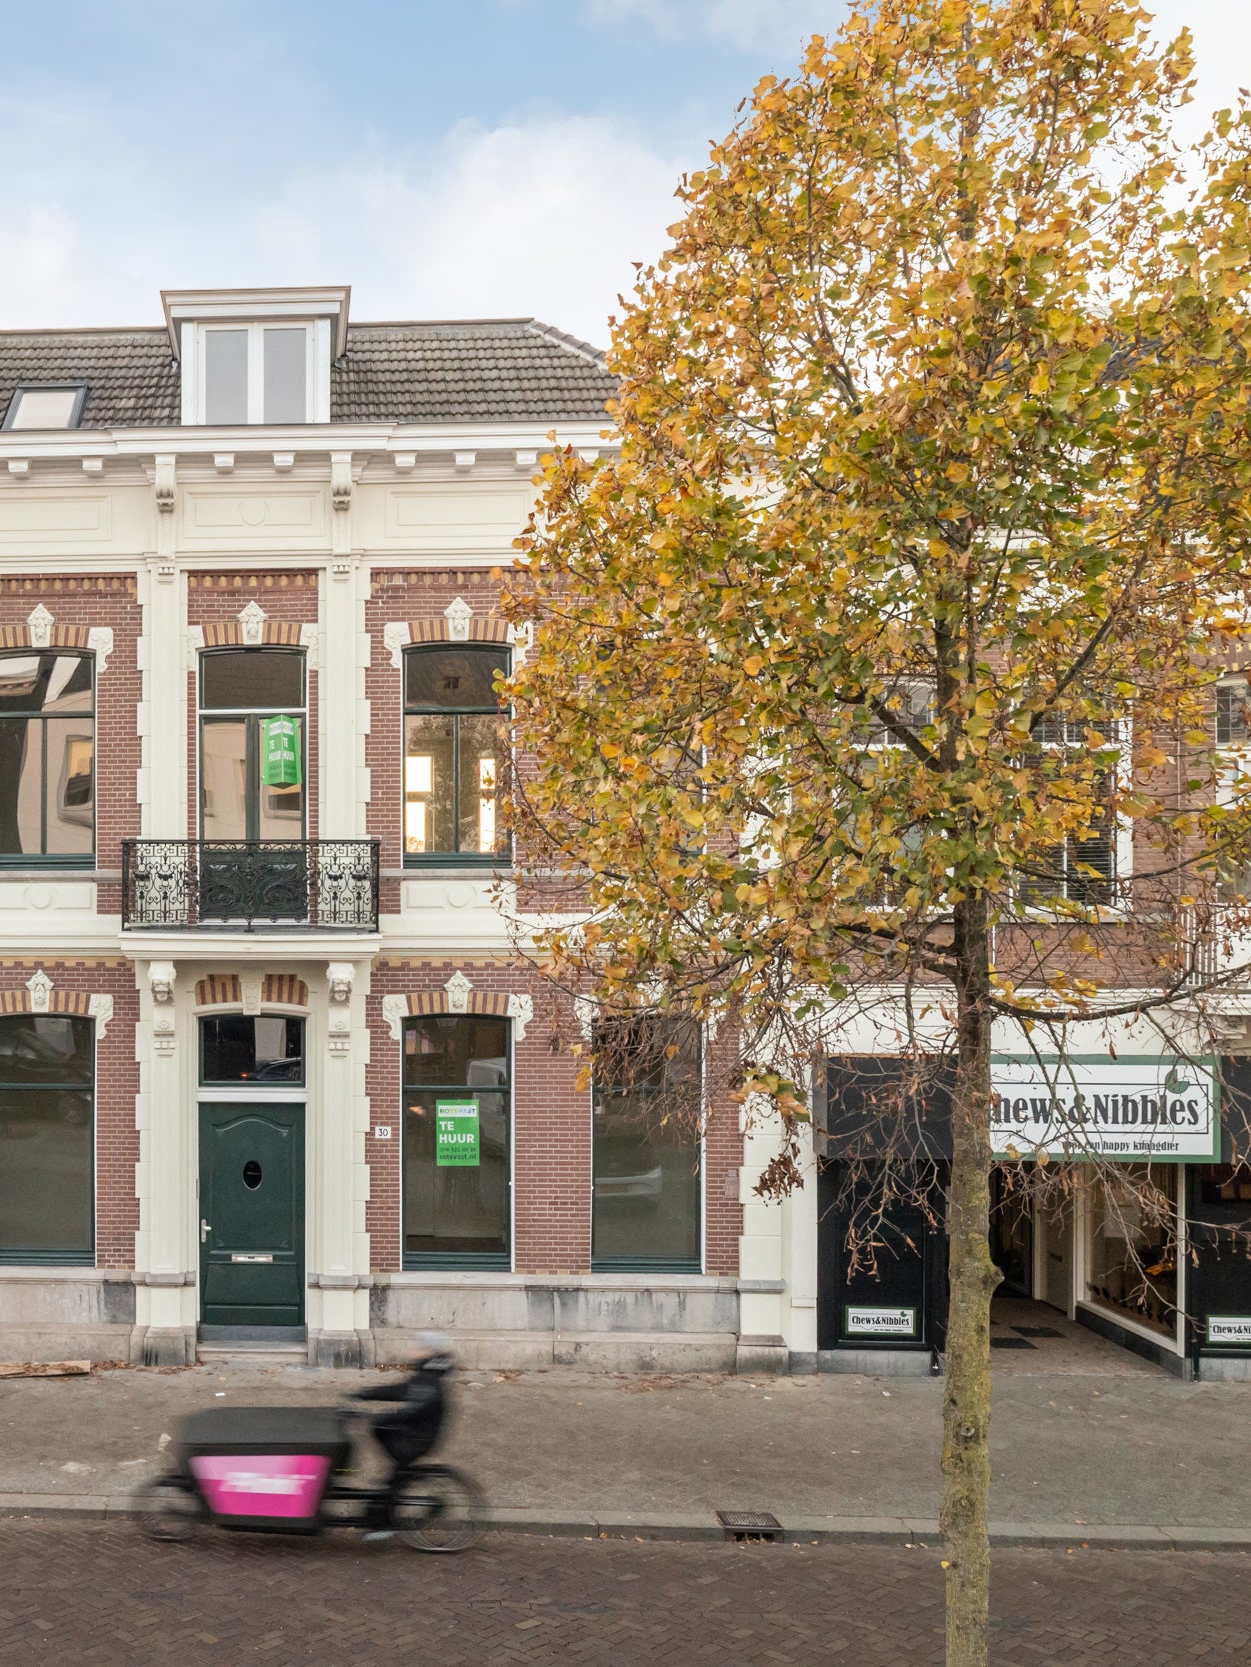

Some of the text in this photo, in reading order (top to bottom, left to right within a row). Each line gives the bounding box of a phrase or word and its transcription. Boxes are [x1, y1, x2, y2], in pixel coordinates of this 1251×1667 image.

[989, 1093, 1199, 1126] hews&Nibbles
[439, 1121, 454, 1130] TE
[439, 1134, 475, 1143] HUUR
[1103, 1141, 1130, 1151] happy
[852, 1316, 909, 1326] Chews&Nibbles
